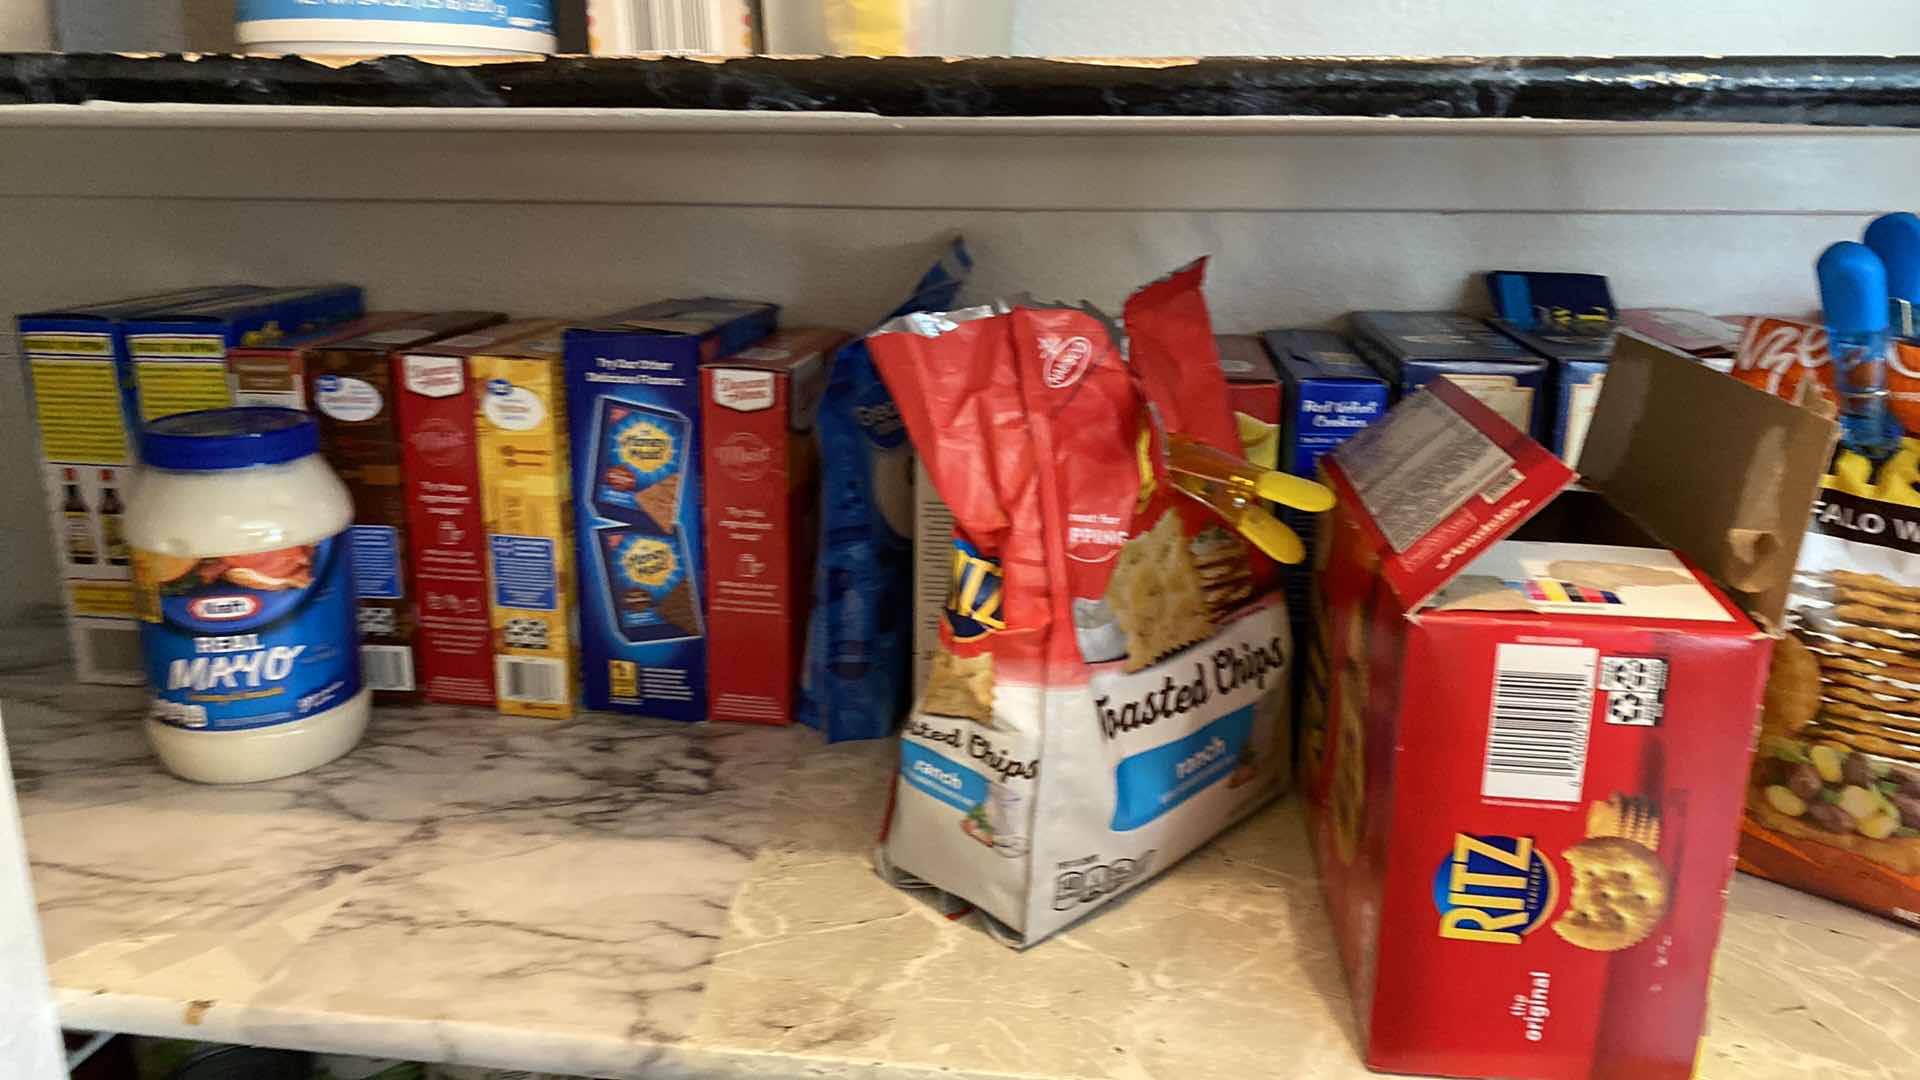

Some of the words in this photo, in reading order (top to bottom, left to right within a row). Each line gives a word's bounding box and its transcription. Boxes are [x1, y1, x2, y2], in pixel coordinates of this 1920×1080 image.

[166, 645, 307, 691] MAYO
[193, 633, 265, 654] REAL
[1096, 663, 1211, 740] Toasted
[1211, 636, 1286, 697] Chips
[967, 733, 1042, 783] Chips
[1438, 832, 1534, 945] RITZ
[1508, 994, 1529, 1016] the
[1523, 971, 1551, 1041] original
